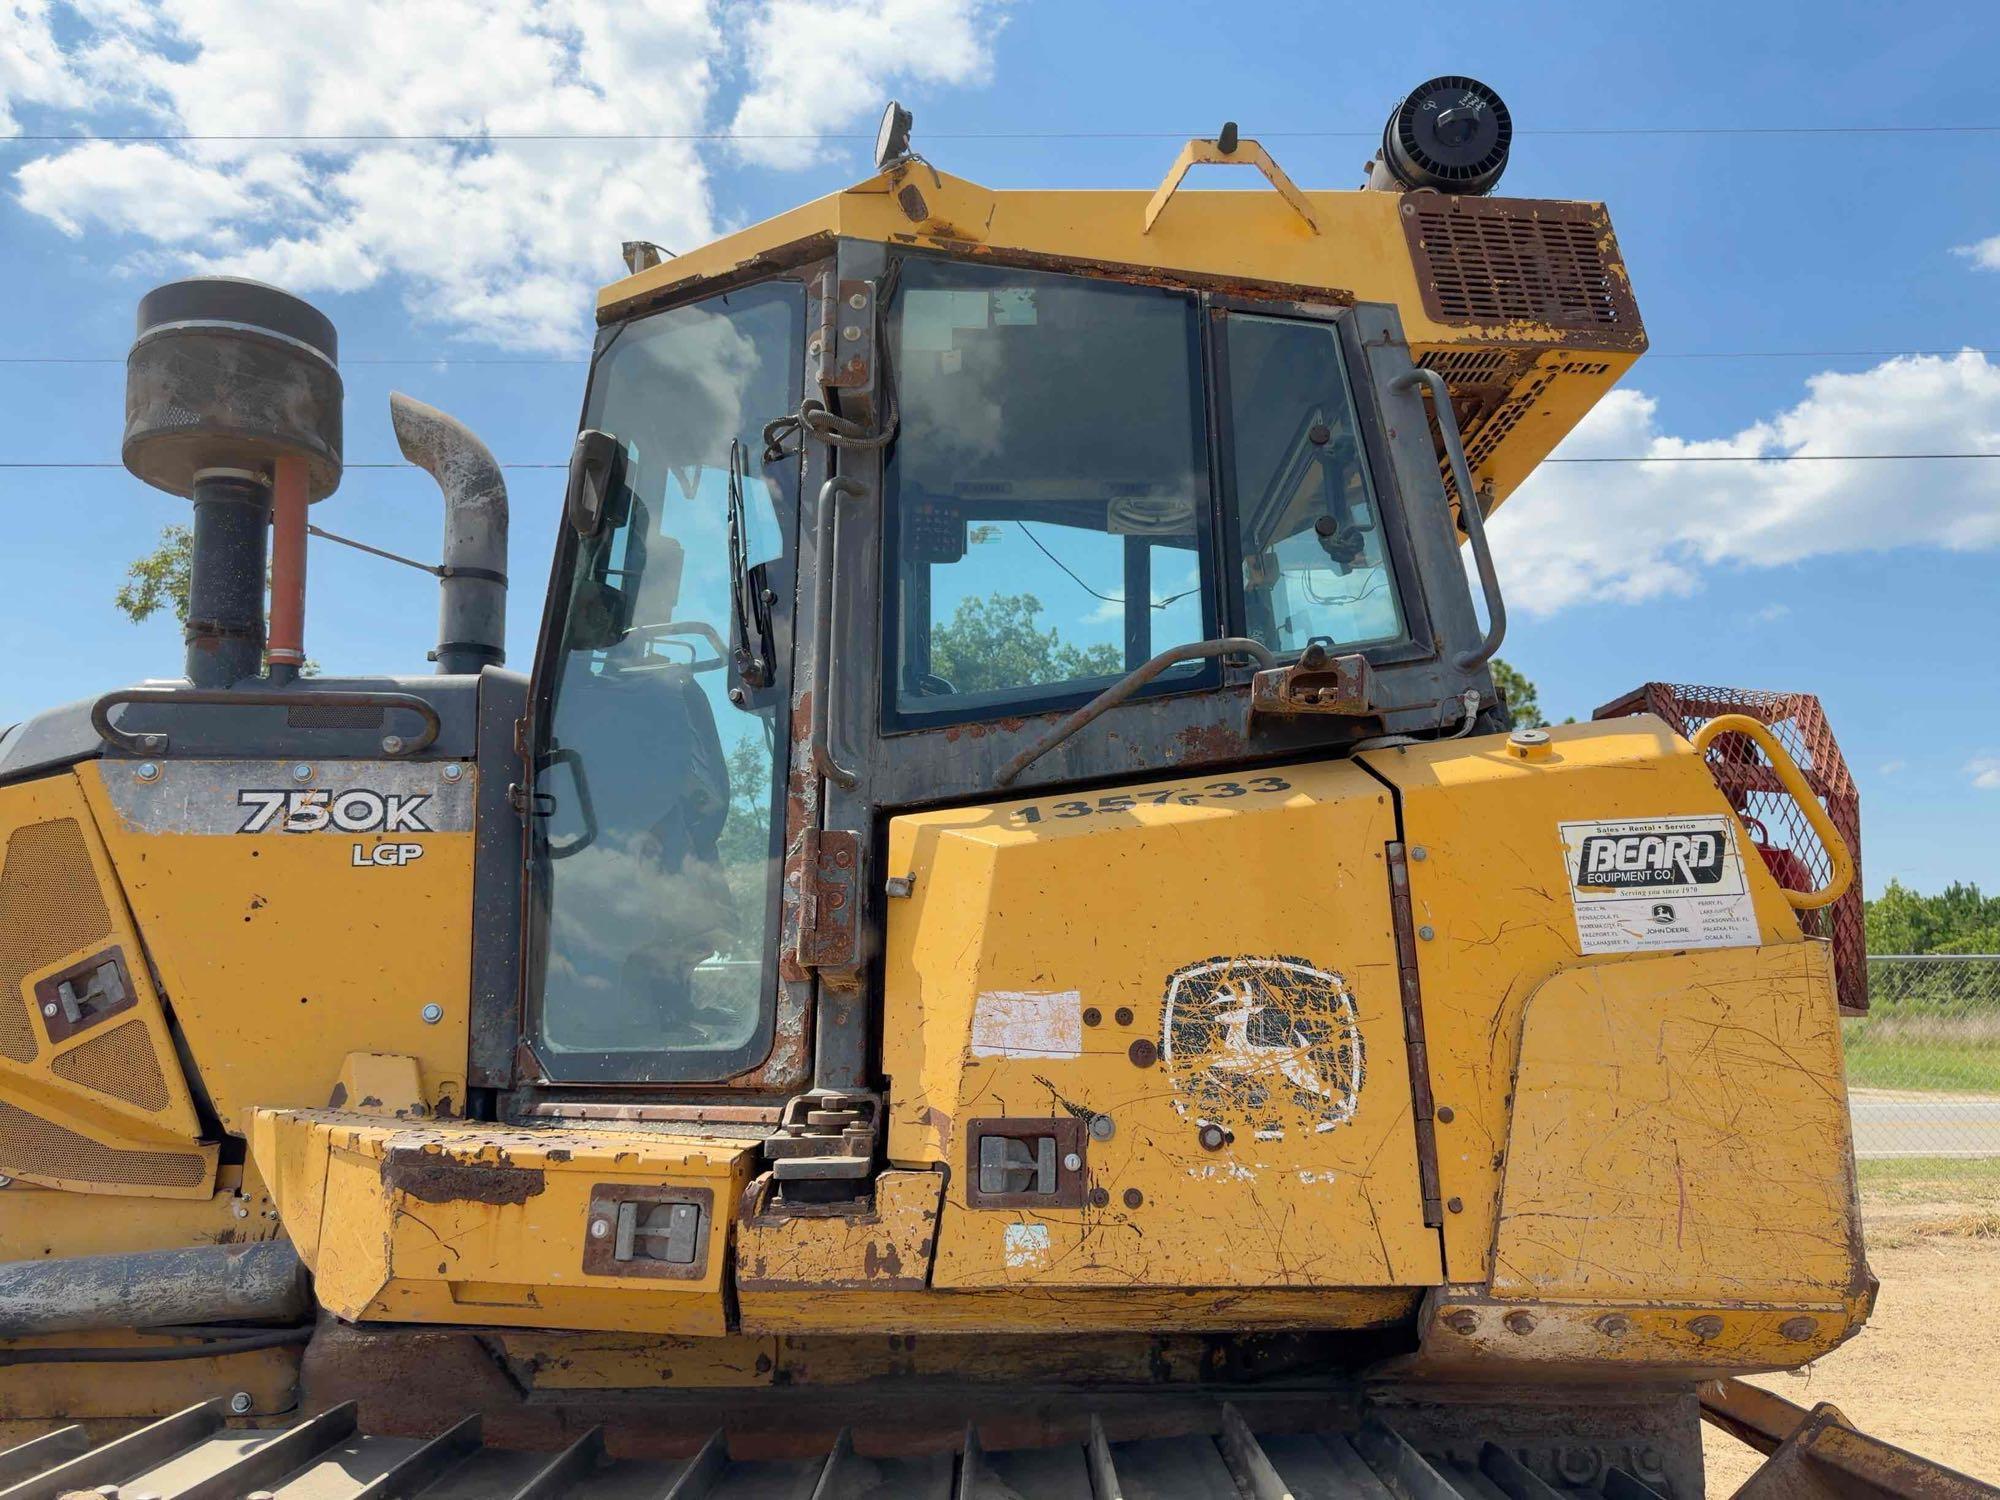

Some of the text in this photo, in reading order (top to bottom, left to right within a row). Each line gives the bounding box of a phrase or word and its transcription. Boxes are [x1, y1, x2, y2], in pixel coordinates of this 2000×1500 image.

[236, 788, 434, 834] 750K
[352, 843, 424, 867] LGP
[1587, 834, 1715, 884] BEARD
[1587, 869, 1673, 883] EQUIPMENT CO.
[1620, 889, 1646, 897] Serving
[1665, 926, 1689, 934] DEERE
